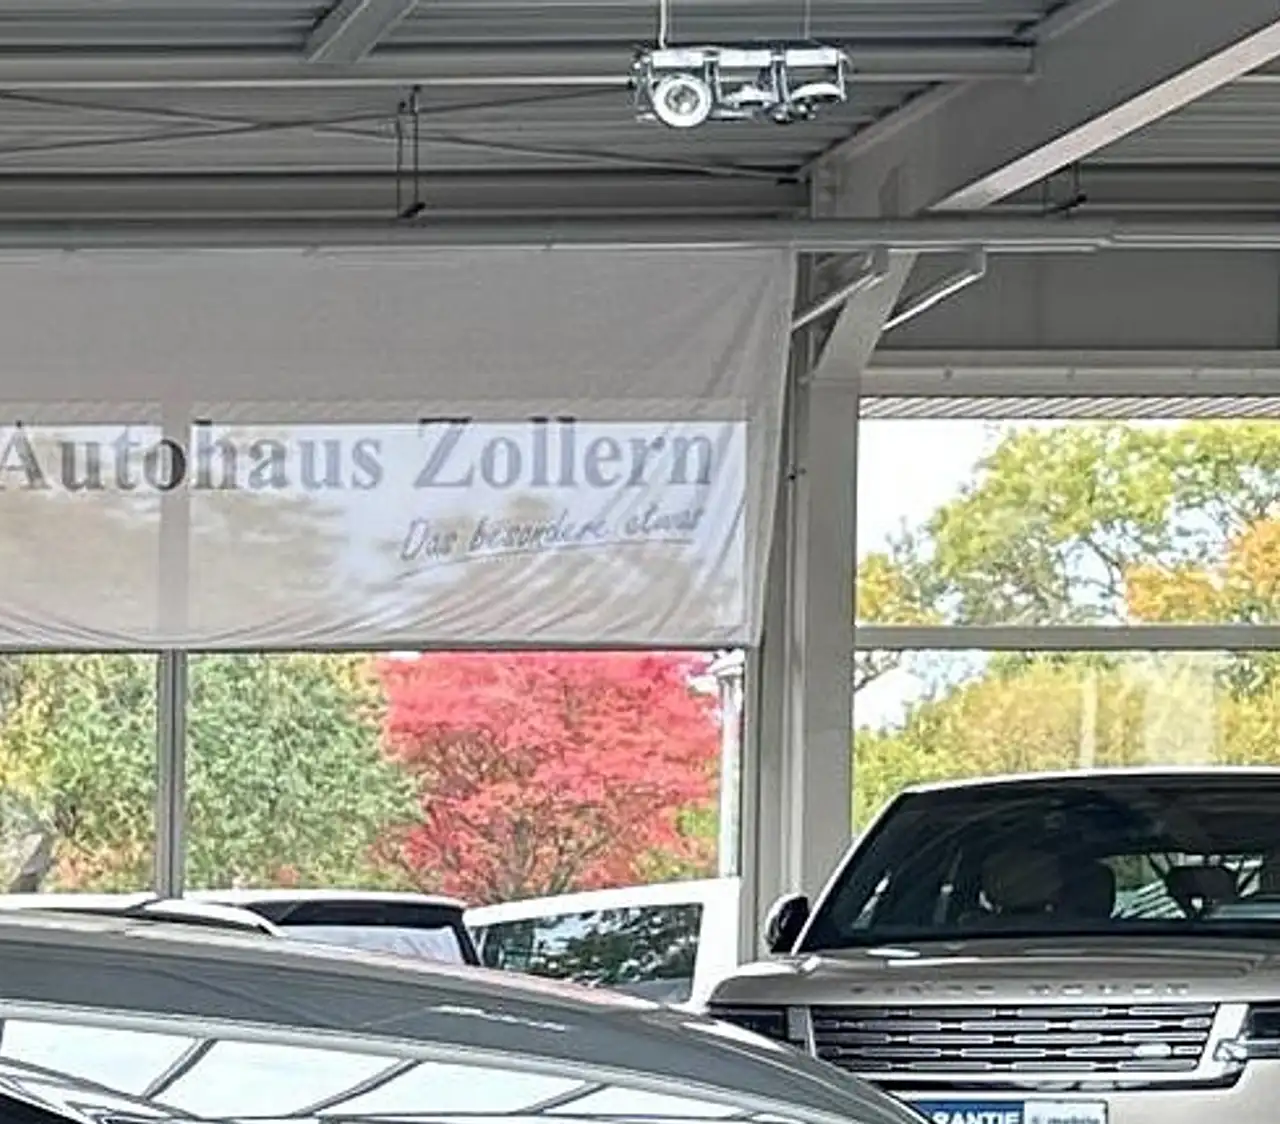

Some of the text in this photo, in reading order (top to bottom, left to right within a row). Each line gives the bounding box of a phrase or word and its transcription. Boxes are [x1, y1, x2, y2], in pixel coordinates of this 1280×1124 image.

[413, 415, 714, 489] Zollern
[400, 501, 704, 560] Das besondere etwas
